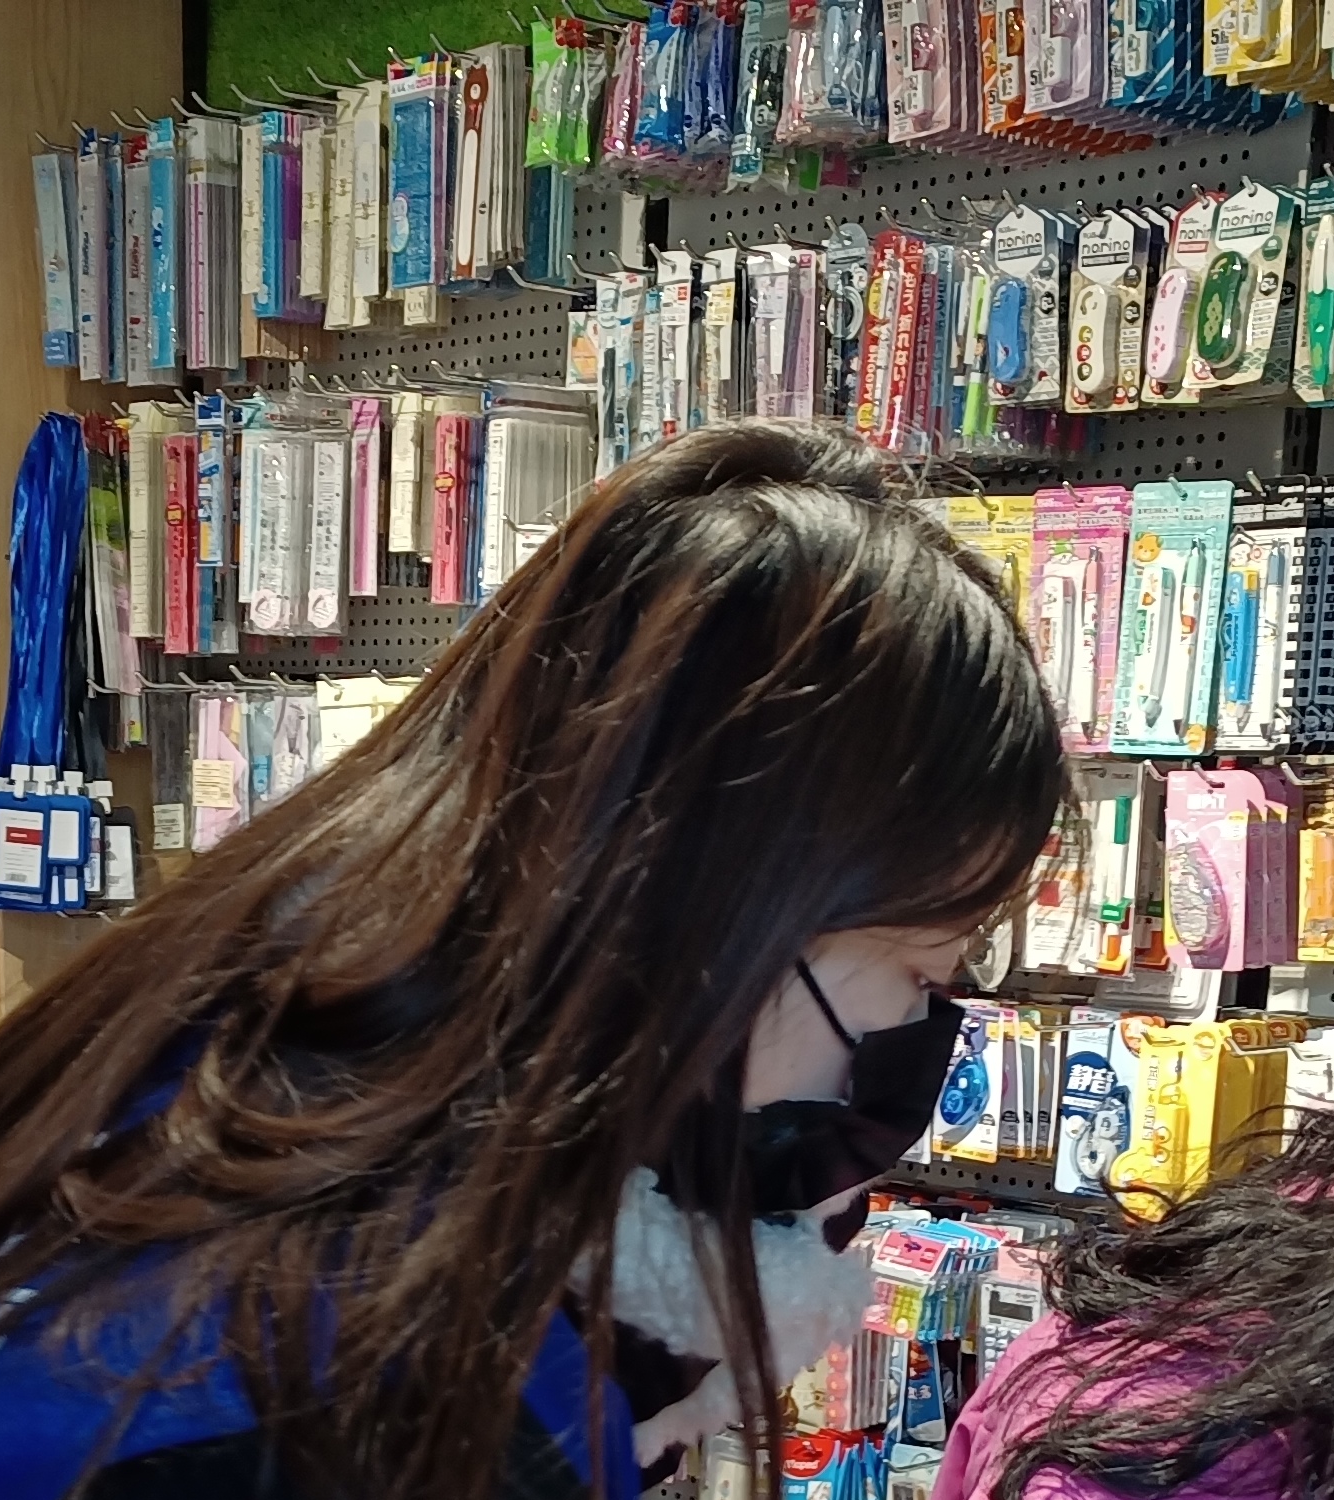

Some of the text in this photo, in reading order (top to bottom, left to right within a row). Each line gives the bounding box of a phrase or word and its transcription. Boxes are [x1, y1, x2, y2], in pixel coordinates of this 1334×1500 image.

[1220, 207, 1274, 229] norino
[998, 231, 1042, 249] norino
[1082, 239, 1130, 255] norino
[1067, 1063, 1115, 1094] 静音
